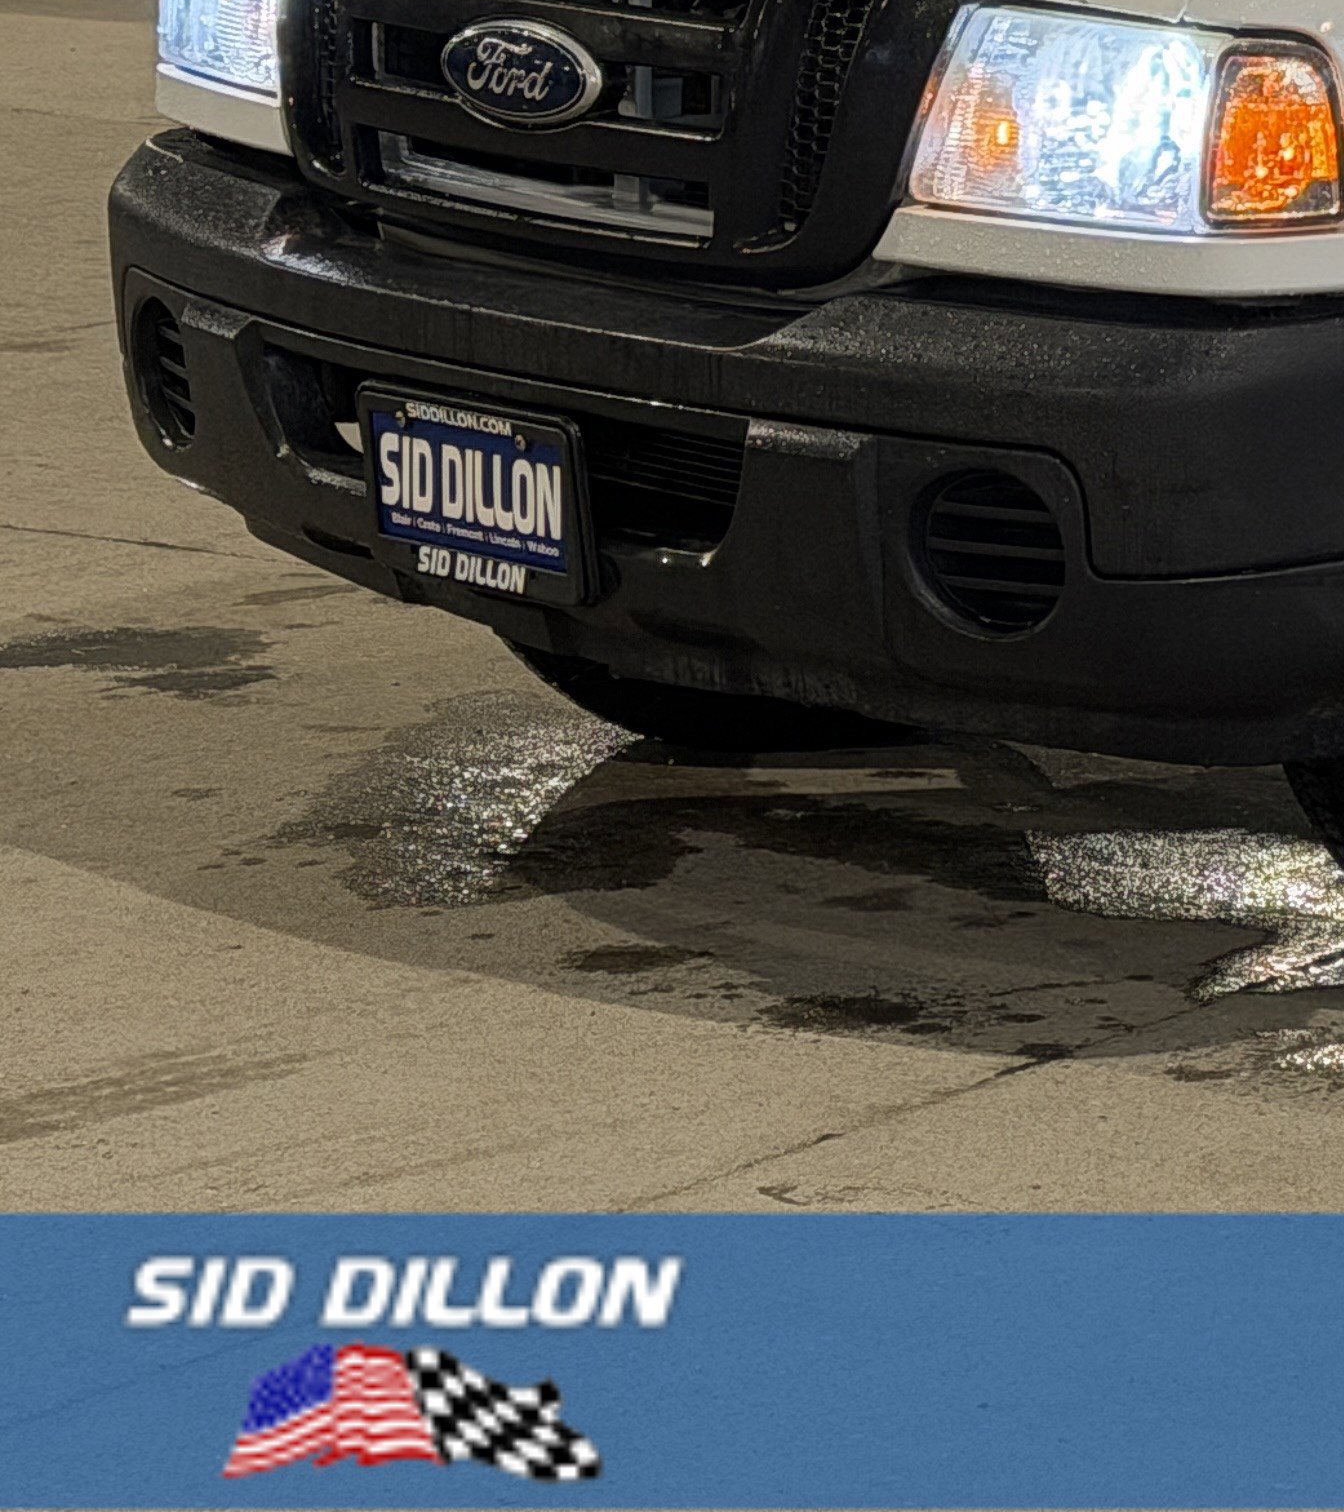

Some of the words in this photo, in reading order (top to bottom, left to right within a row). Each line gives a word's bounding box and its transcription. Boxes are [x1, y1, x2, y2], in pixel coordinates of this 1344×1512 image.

[467, 38, 554, 101] Ford
[405, 402, 512, 437] SIDDILLON.COM
[380, 432, 434, 514] SID
[441, 443, 562, 541] DILLON
[417, 546, 451, 578] SID
[454, 553, 527, 595] DILLON
